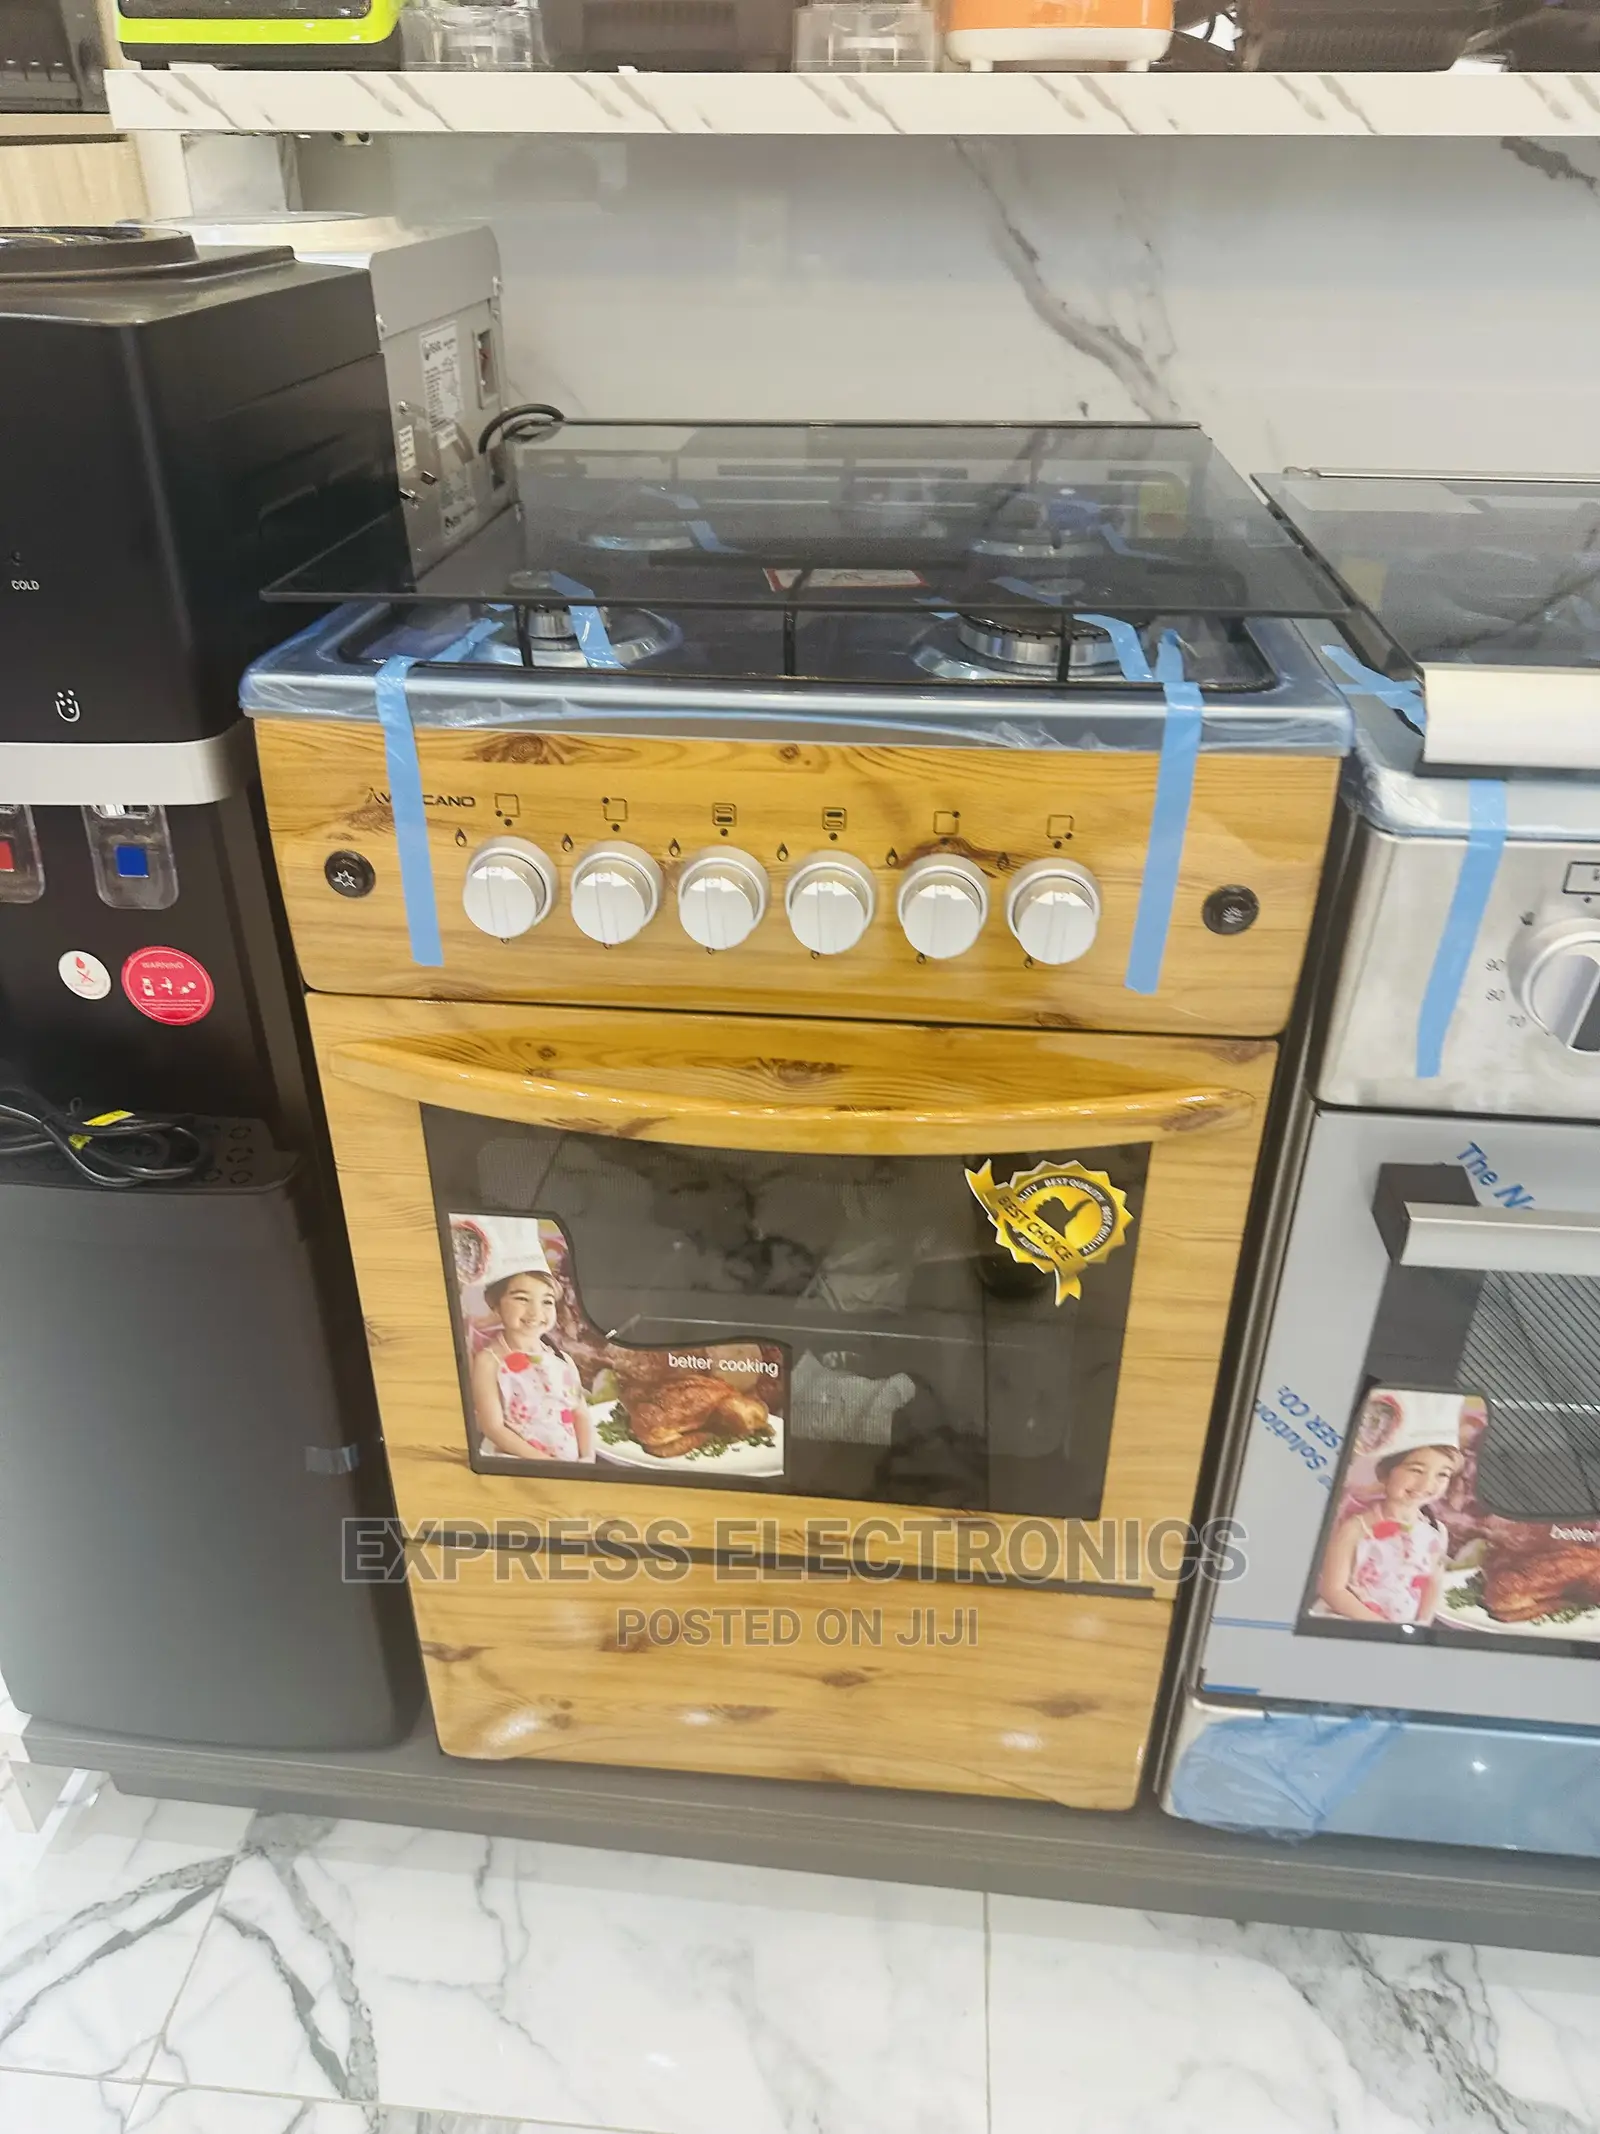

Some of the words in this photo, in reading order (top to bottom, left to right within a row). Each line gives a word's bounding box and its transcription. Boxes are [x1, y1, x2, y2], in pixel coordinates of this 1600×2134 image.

[11, 579, 40, 591] COLD
[380, 791, 476, 808] VCANO
[140, 961, 185, 970] WARNING
[1043, 1177, 1068, 1188] BEST
[1456, 1140, 1499, 1187] The
[1493, 1183, 1537, 1210] N
[998, 1196, 1031, 1223] BEST
[1026, 1221, 1074, 1262] CHOICE
[1081, 1225, 1112, 1256] QUALITY
[667, 1351, 713, 1371] better
[718, 1358, 780, 1379] cooking
[1305, 1414, 1344, 1450] SER
